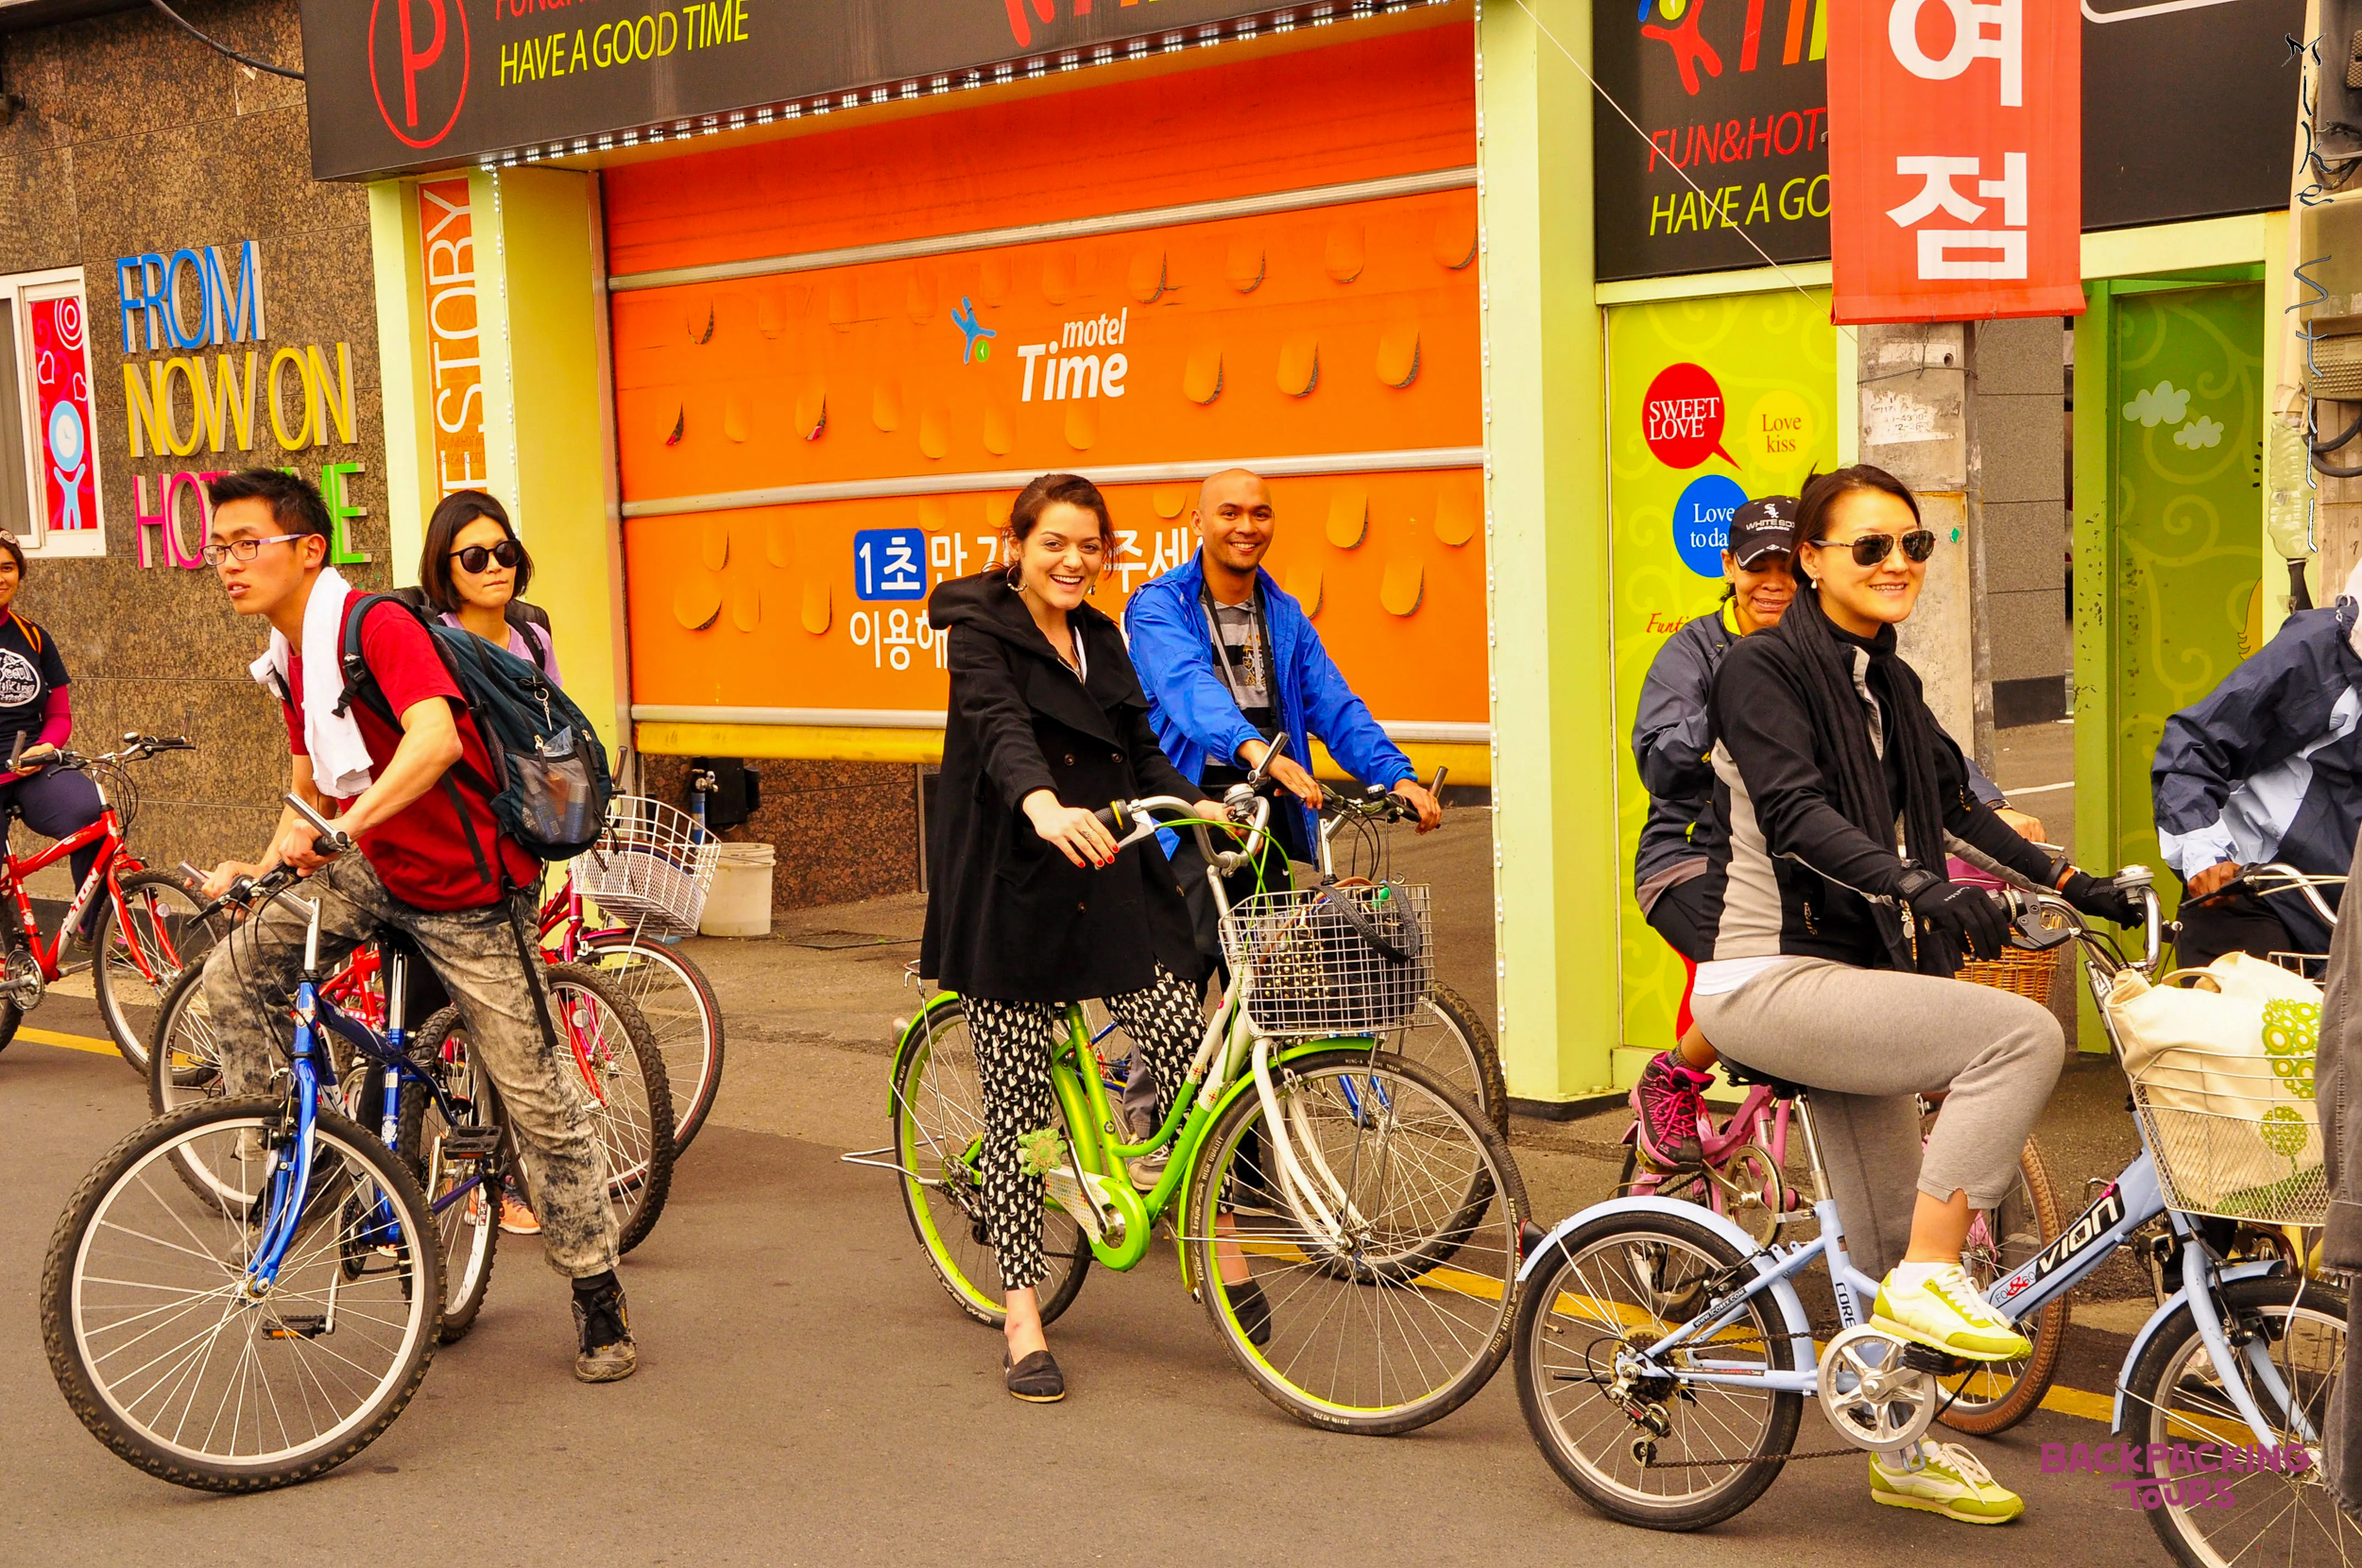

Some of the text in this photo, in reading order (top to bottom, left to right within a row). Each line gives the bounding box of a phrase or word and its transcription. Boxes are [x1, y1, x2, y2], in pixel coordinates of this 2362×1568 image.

[500, 0, 750, 87] HAVE A GOOD TIME
[1649, 184, 1740, 236] HAVE
[1745, 182, 1772, 226] A
[116, 240, 264, 353] FROM
[423, 189, 485, 434] STORY
[1062, 307, 1128, 349] motel
[1018, 341, 1128, 402] Time
[123, 341, 356, 458] NOW ON
[1649, 397, 1720, 422] SWEET
[1761, 414, 1802, 433] Love
[1649, 418, 1705, 441] LOVE
[1766, 435, 1797, 453] kiss
[133, 470, 230, 569] HO
[1693, 503, 1736, 523] Love
[1746, 519, 1778, 530] WHITE
[1202, 1136, 1224, 1182] HIGH QUALITY
[1490, 1304, 1514, 1354] DELUXE CYCLE
